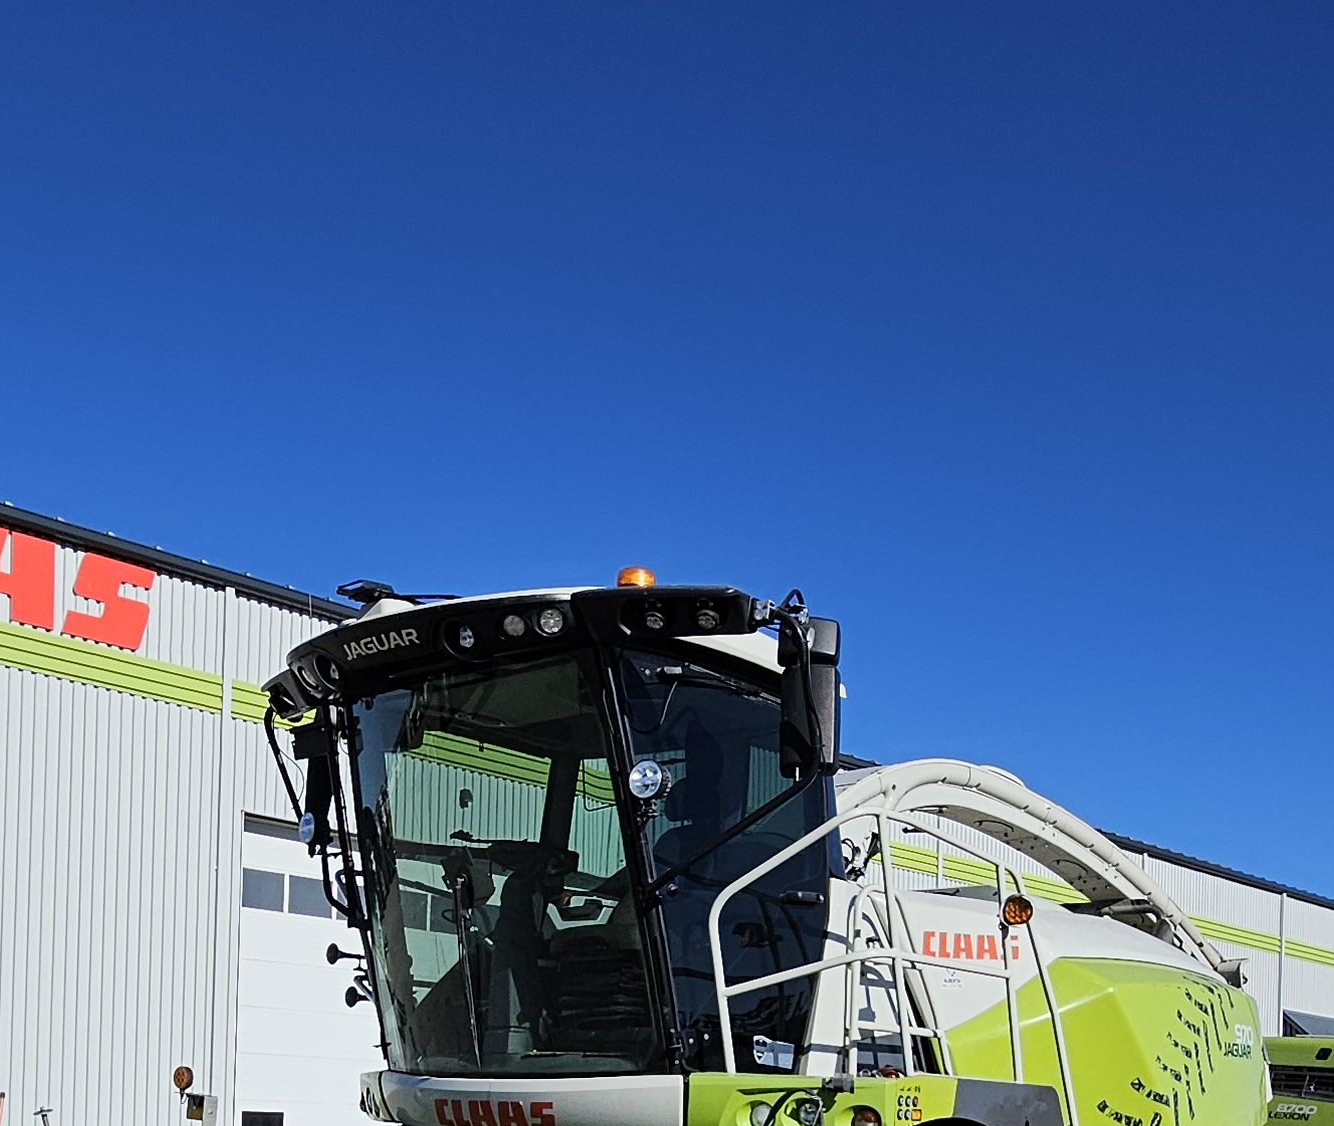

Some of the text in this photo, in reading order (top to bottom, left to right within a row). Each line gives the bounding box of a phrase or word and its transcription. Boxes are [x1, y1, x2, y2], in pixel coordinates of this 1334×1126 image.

[343, 628, 421, 661] JAGUAR
[1234, 1023, 1255, 1046] 970
[1223, 1041, 1252, 1060] JAGUAR
[1268, 1110, 1311, 1122] LEXION
[1276, 1102, 1318, 1115] 8700
